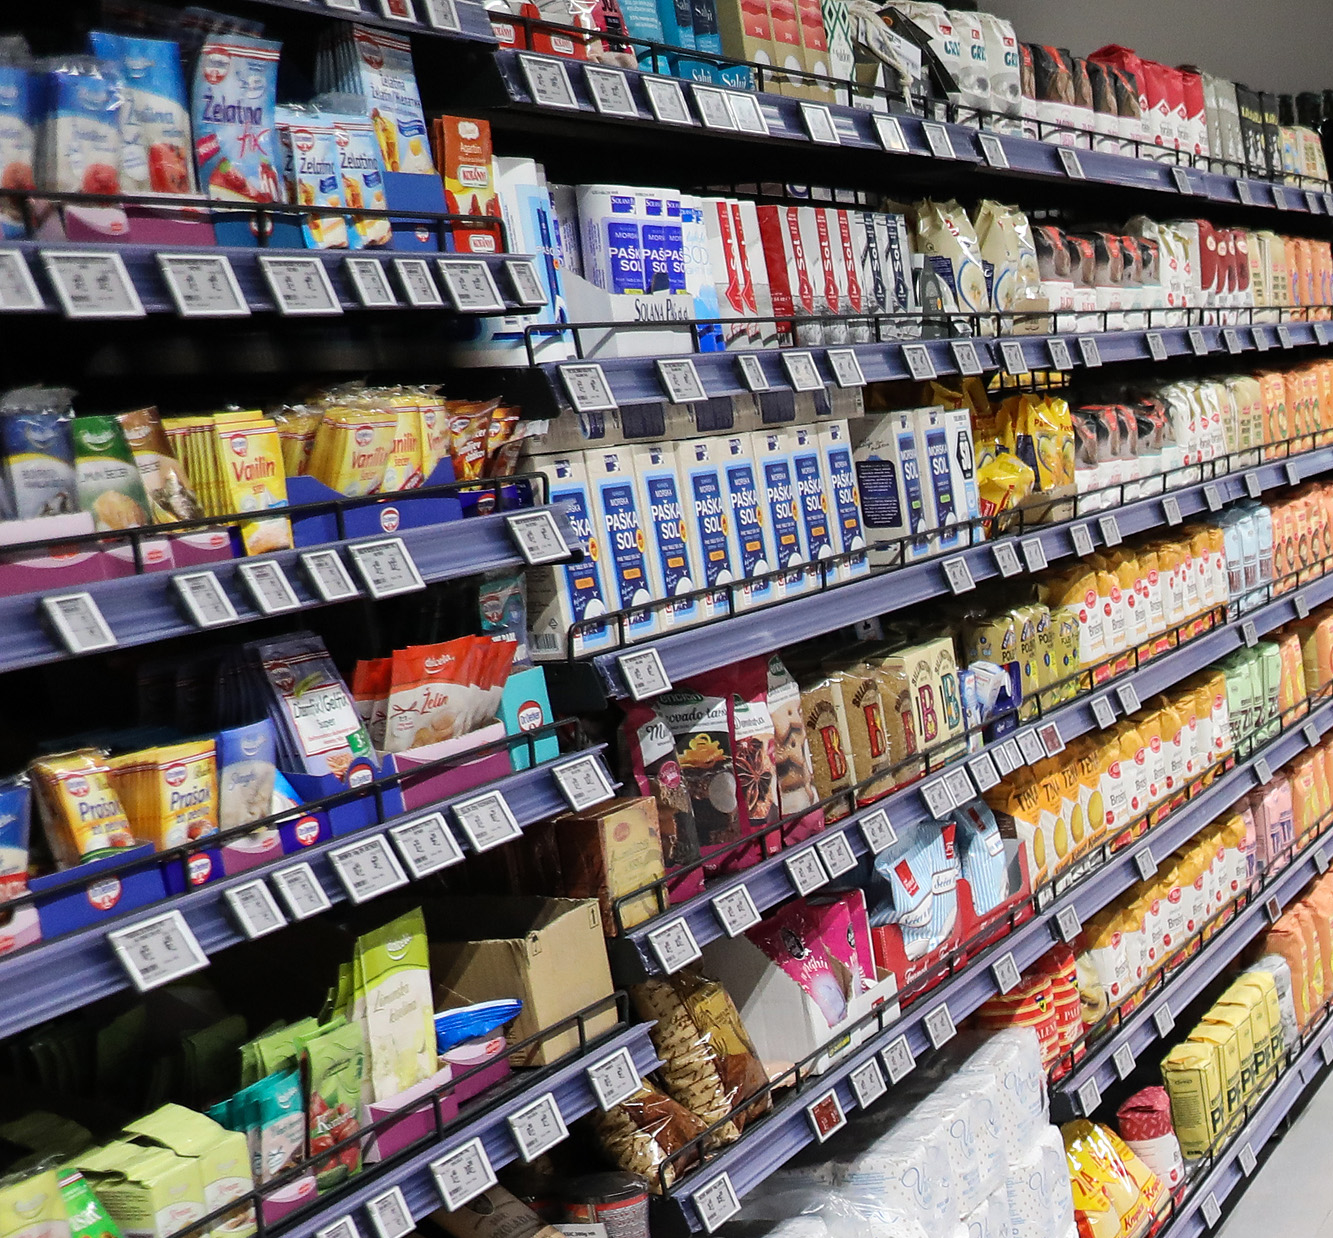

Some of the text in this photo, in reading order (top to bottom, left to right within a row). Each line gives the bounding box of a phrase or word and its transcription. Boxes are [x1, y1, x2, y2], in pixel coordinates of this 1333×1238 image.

[798, 478, 823, 496] PAŠKA
[832, 472, 855, 488] PAŠKA
[730, 488, 758, 508] PAŠKA
[768, 484, 794, 502] PAŠKA
[839, 488, 854, 503] SOL
[652, 500, 681, 521] PAŠKA
[695, 497, 724, 517] PAŠKA
[776, 502, 793, 518] SOL
[806, 495, 822, 512] SOL
[606, 510, 639, 532] PAŠKA
[704, 516, 722, 533] SOL
[739, 508, 757, 525] SOL
[661, 522, 680, 539] SOL
[617, 532, 637, 550] SOL
